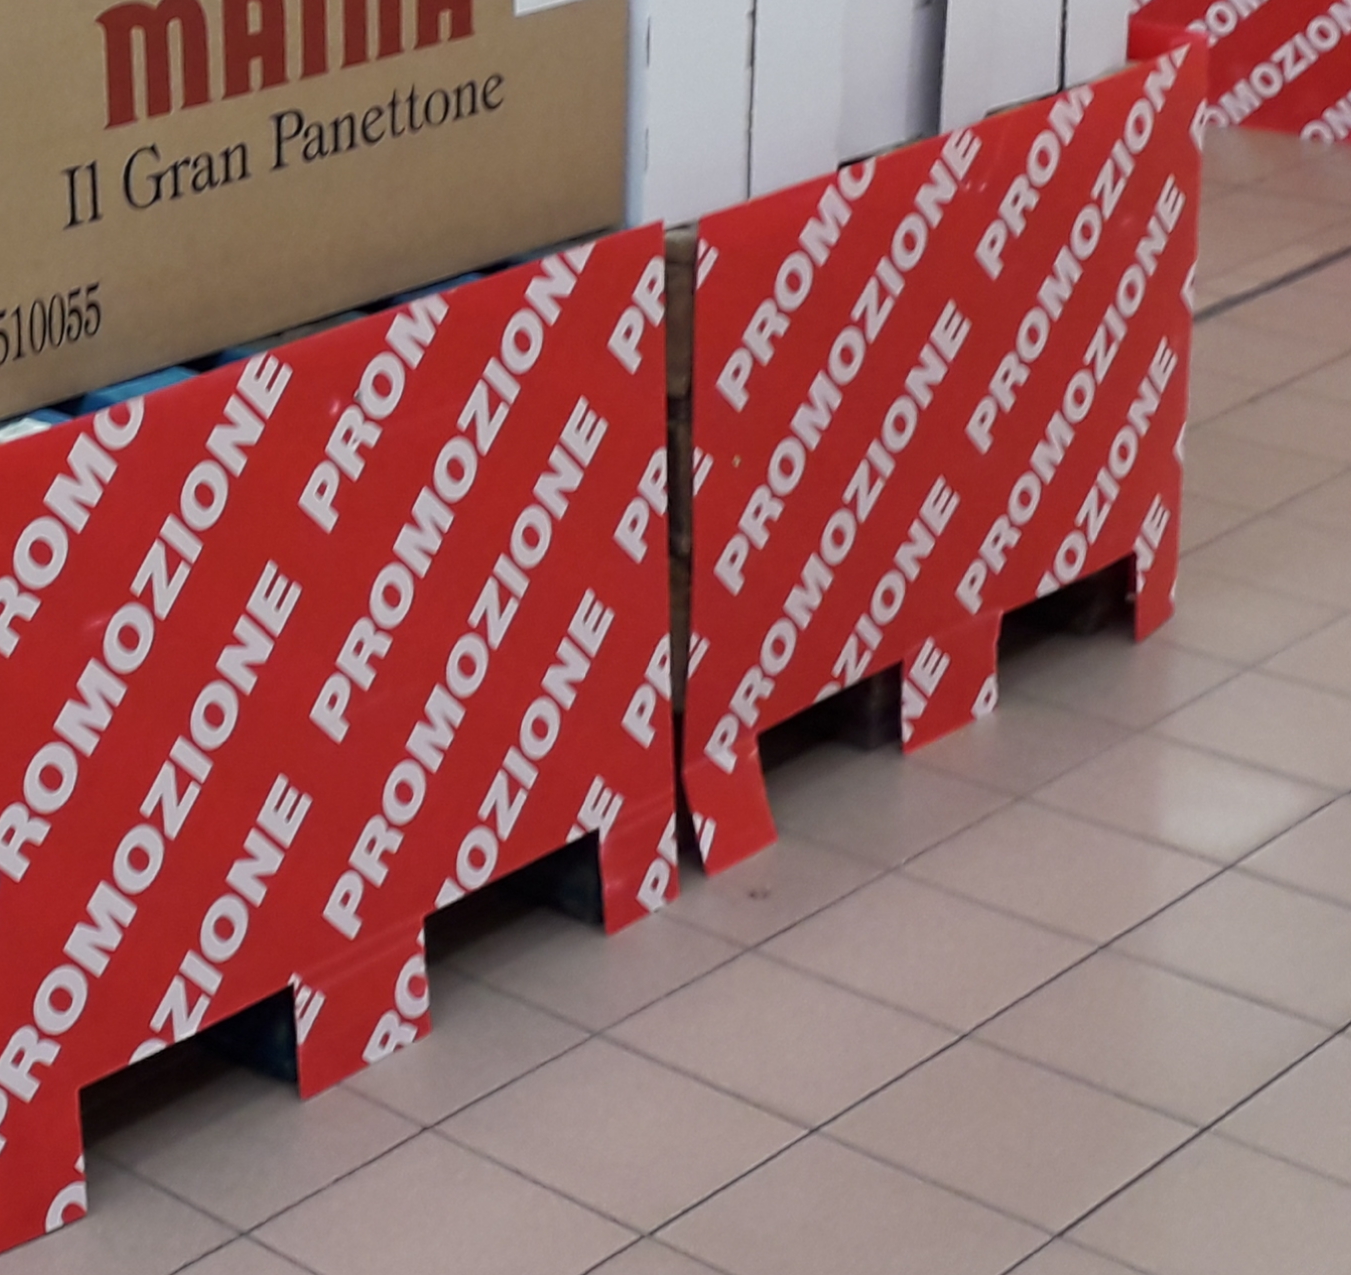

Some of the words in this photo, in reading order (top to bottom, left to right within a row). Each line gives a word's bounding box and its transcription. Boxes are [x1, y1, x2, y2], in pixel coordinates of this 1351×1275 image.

[62, 159, 103, 231] Il
[122, 141, 251, 213] Gran
[269, 71, 506, 173] Panettone
[714, 127, 982, 596] PROMOZIONE
[704, 298, 972, 774] PROMOZIONE
[954, 173, 1186, 615] PROMOZIONE
[322, 394, 608, 940] PROMOZIONE
